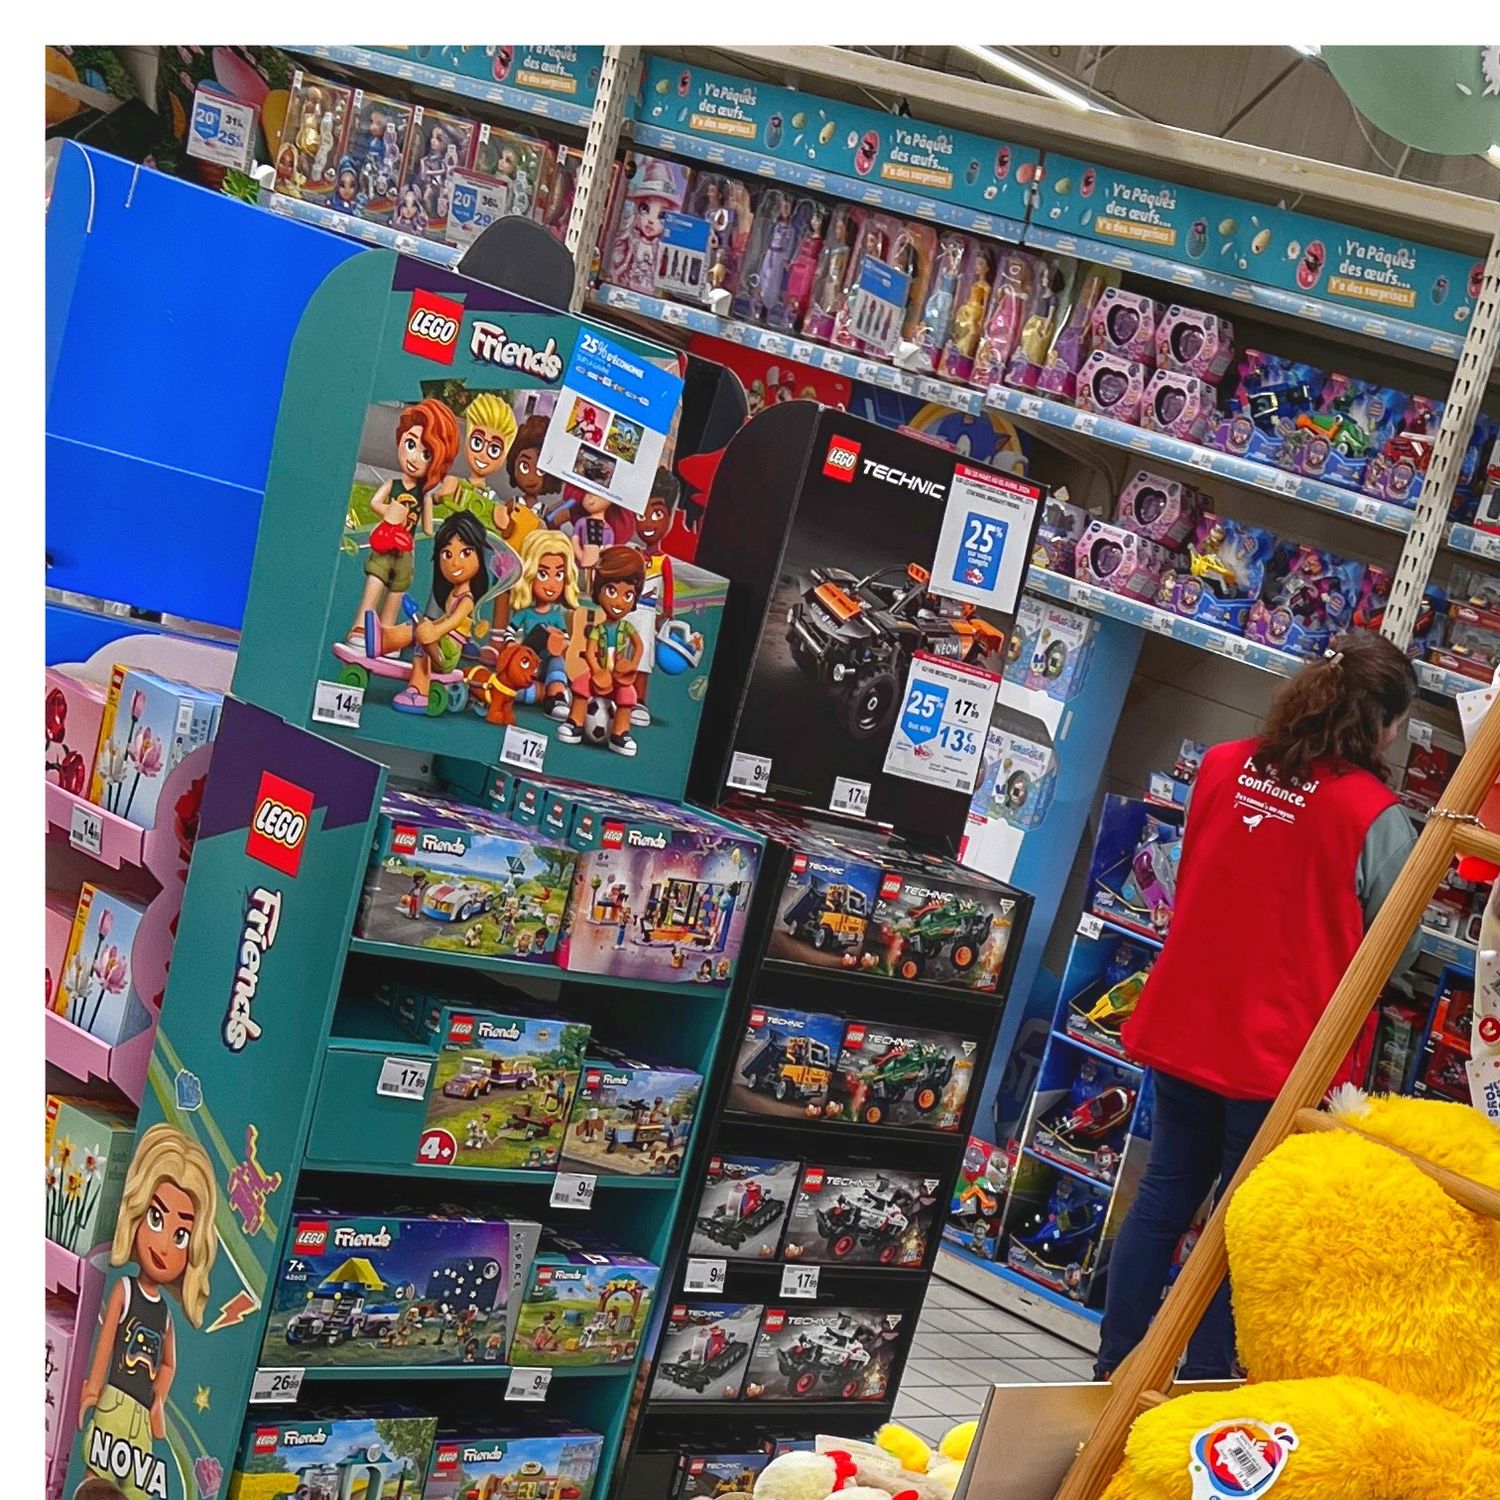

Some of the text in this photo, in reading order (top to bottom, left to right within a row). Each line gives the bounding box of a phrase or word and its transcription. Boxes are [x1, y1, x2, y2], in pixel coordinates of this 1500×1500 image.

[1339, 258, 1362, 277] des
[412, 310, 457, 341] LEGO
[473, 321, 562, 380] Friends
[829, 447, 856, 469] LEGO
[863, 458, 946, 500] TECHNIC
[1238, 772, 1306, 808] confiance.
[256, 802, 304, 846] LEGO
[395, 833, 466, 856] LEGO Friends
[604, 829, 667, 850] LEGO Friends
[904, 884, 954, 902] TECHNIC
[225, 887, 281, 1050] Friends
[451, 1022, 520, 1041] LEGO Friends
[867, 1034, 918, 1049] TECHNIC
[420, 1136, 453, 1160] 4+
[826, 1176, 877, 1189] TECHNIC
[298, 1226, 391, 1248] LEGO Friends
[288, 1259, 305, 1272] 7+
[284, 1427, 327, 1446] Friends
[90, 1430, 168, 1499] NOVA
[463, 1445, 502, 1462] Friends
